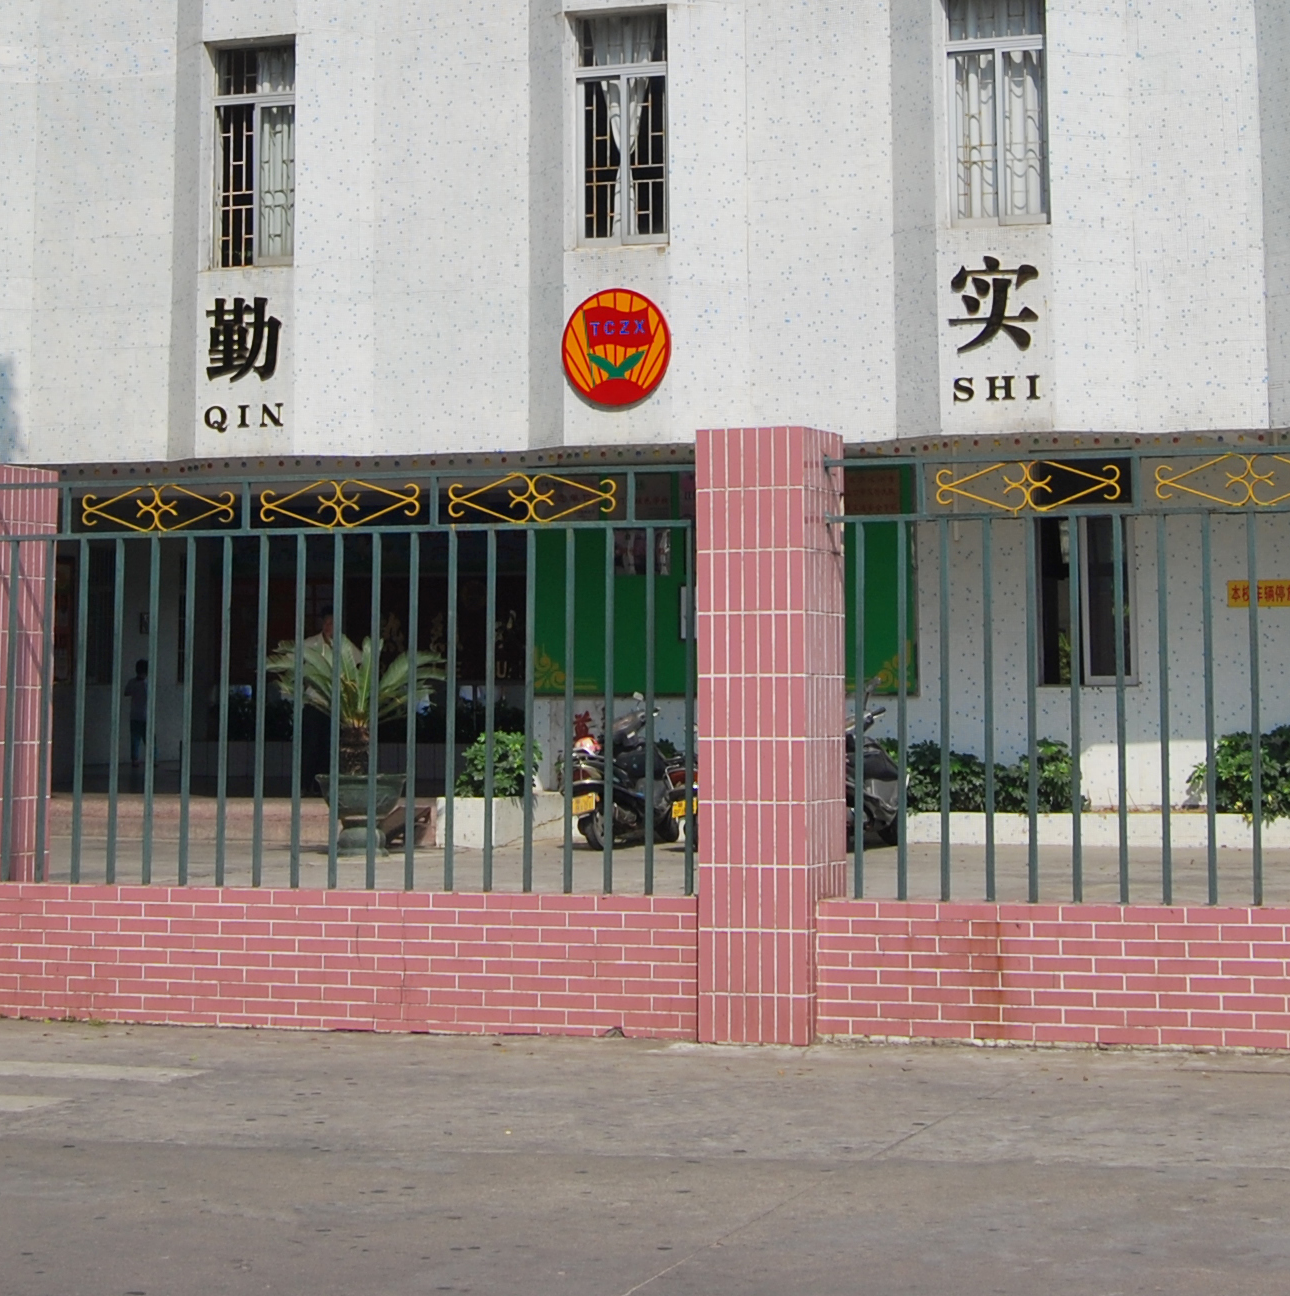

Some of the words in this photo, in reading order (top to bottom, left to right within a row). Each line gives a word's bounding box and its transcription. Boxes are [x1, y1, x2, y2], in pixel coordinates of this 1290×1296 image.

[948, 256, 1040, 355] 实
[205, 296, 283, 384] 勤
[589, 318, 646, 337] TCZX
[952, 374, 1041, 403] SHI
[203, 402, 285, 434] QIN
